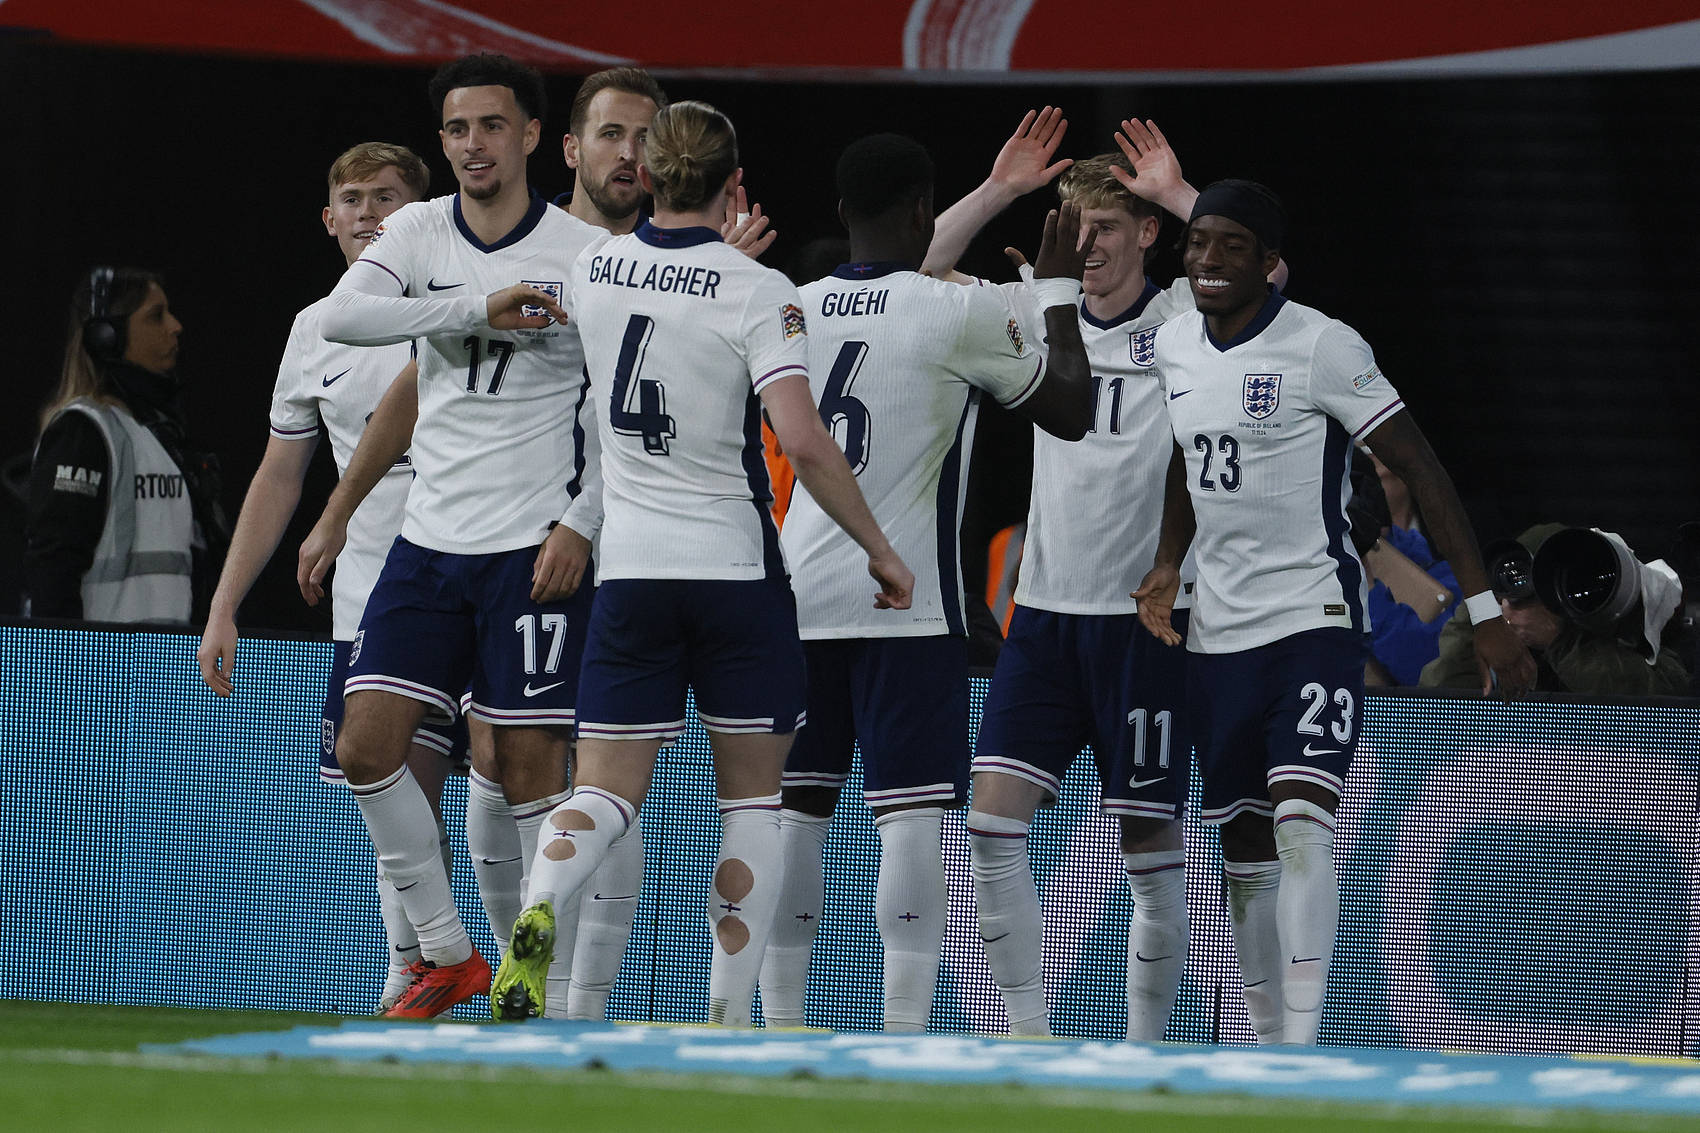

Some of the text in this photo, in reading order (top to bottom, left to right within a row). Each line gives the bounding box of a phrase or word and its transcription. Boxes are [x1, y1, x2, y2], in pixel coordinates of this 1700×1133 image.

[589, 255, 721, 299] GALLAGHER
[821, 287, 889, 317] GUÉHI
[464, 335, 515, 395] 17
[610, 313, 676, 456] 4
[818, 341, 871, 477] 6
[1088, 376, 1125, 434] 11
[55, 464, 102, 486] MAN
[1194, 433, 1243, 493] 23
[515, 613, 567, 675] 17
[1128, 708, 1172, 769] 11
[1297, 682, 1354, 744] 23
